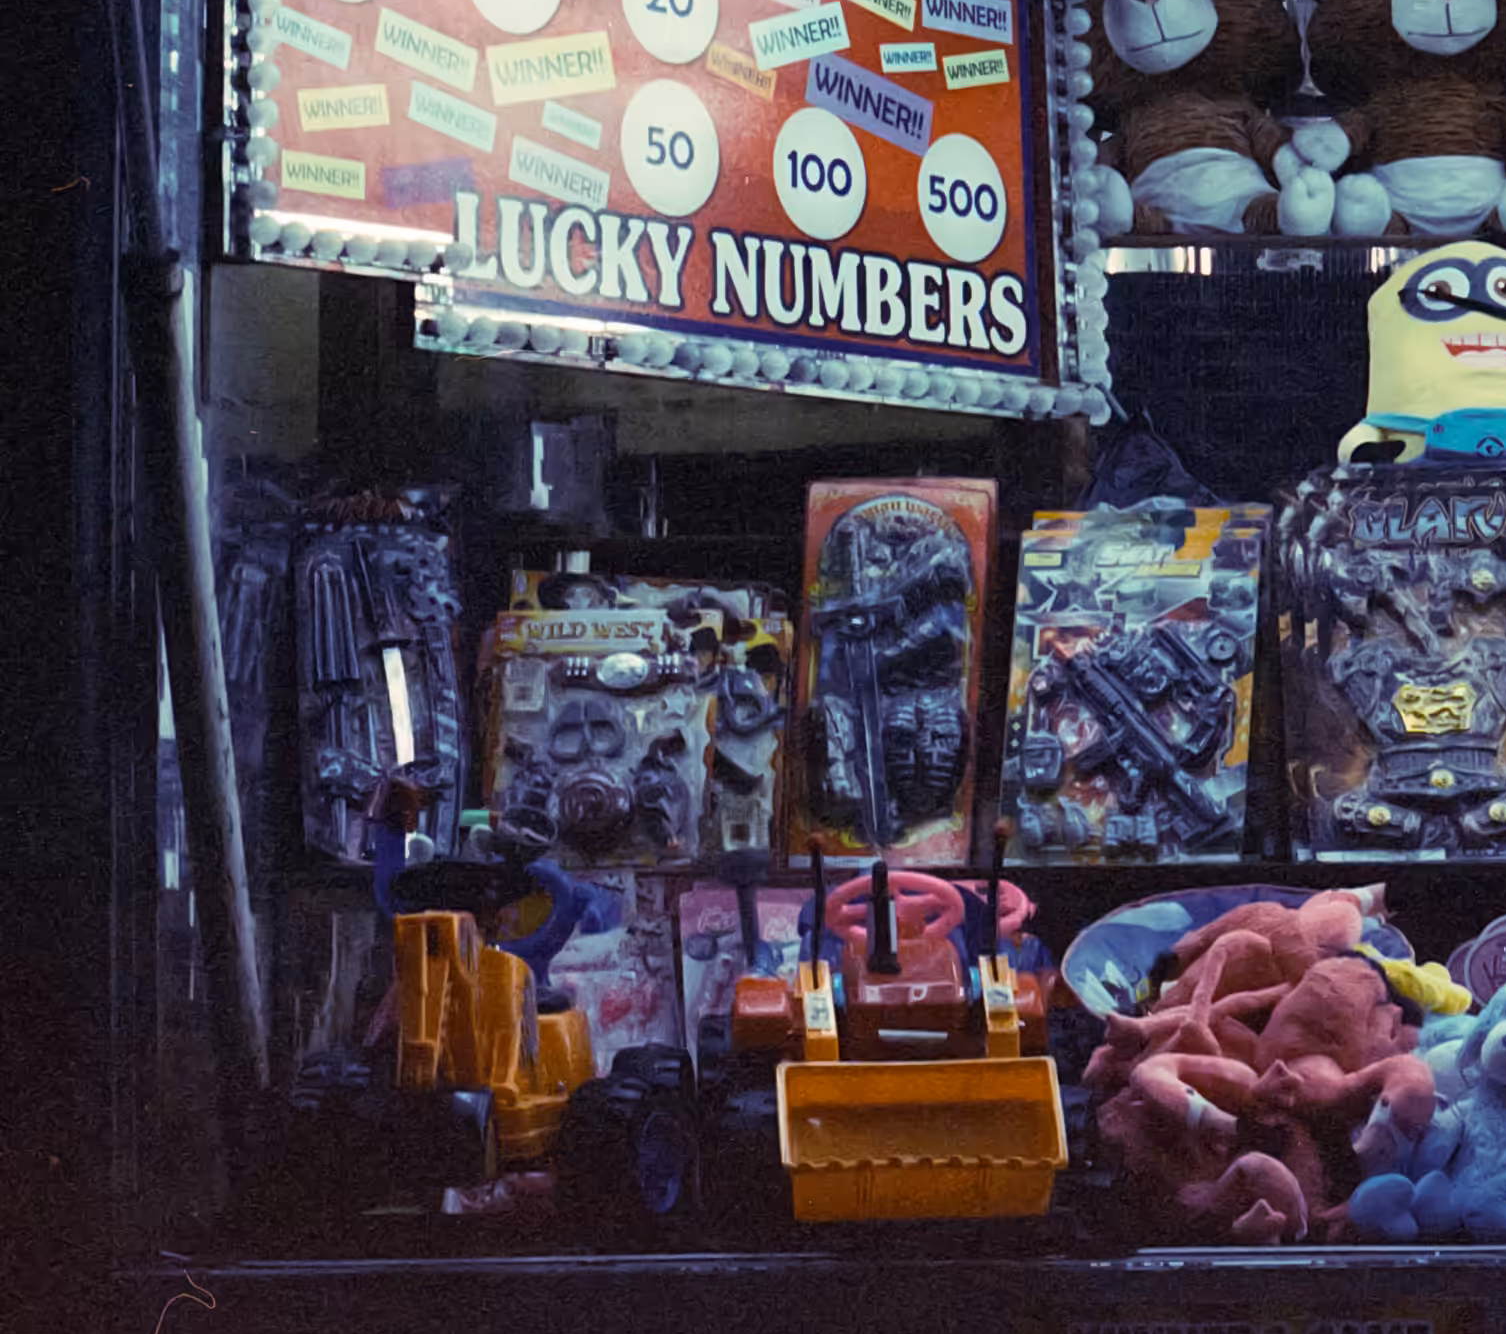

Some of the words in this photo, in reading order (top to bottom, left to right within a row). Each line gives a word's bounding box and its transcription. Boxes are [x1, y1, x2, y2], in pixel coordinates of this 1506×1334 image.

[382, 20, 472, 77] WINNER!!
[755, 14, 843, 57] WINNER!!
[494, 48, 606, 88] WINNER!!
[882, 49, 934, 66] WINNER!!
[945, 59, 1005, 82] WINNER!!
[302, 95, 385, 121] WINNER!!
[813, 61, 926, 140] WINNER!!
[645, 126, 695, 170] 50
[285, 159, 361, 188] WINNER!!
[514, 150, 605, 205] WINNER!!
[786, 148, 853, 197] 100
[927, 174, 998, 223] 500
[454, 191, 695, 310] LUCKY
[711, 228, 1028, 357] NUMBERS
[525, 619, 587, 640] WILD
[590, 620, 656, 640] WEST
